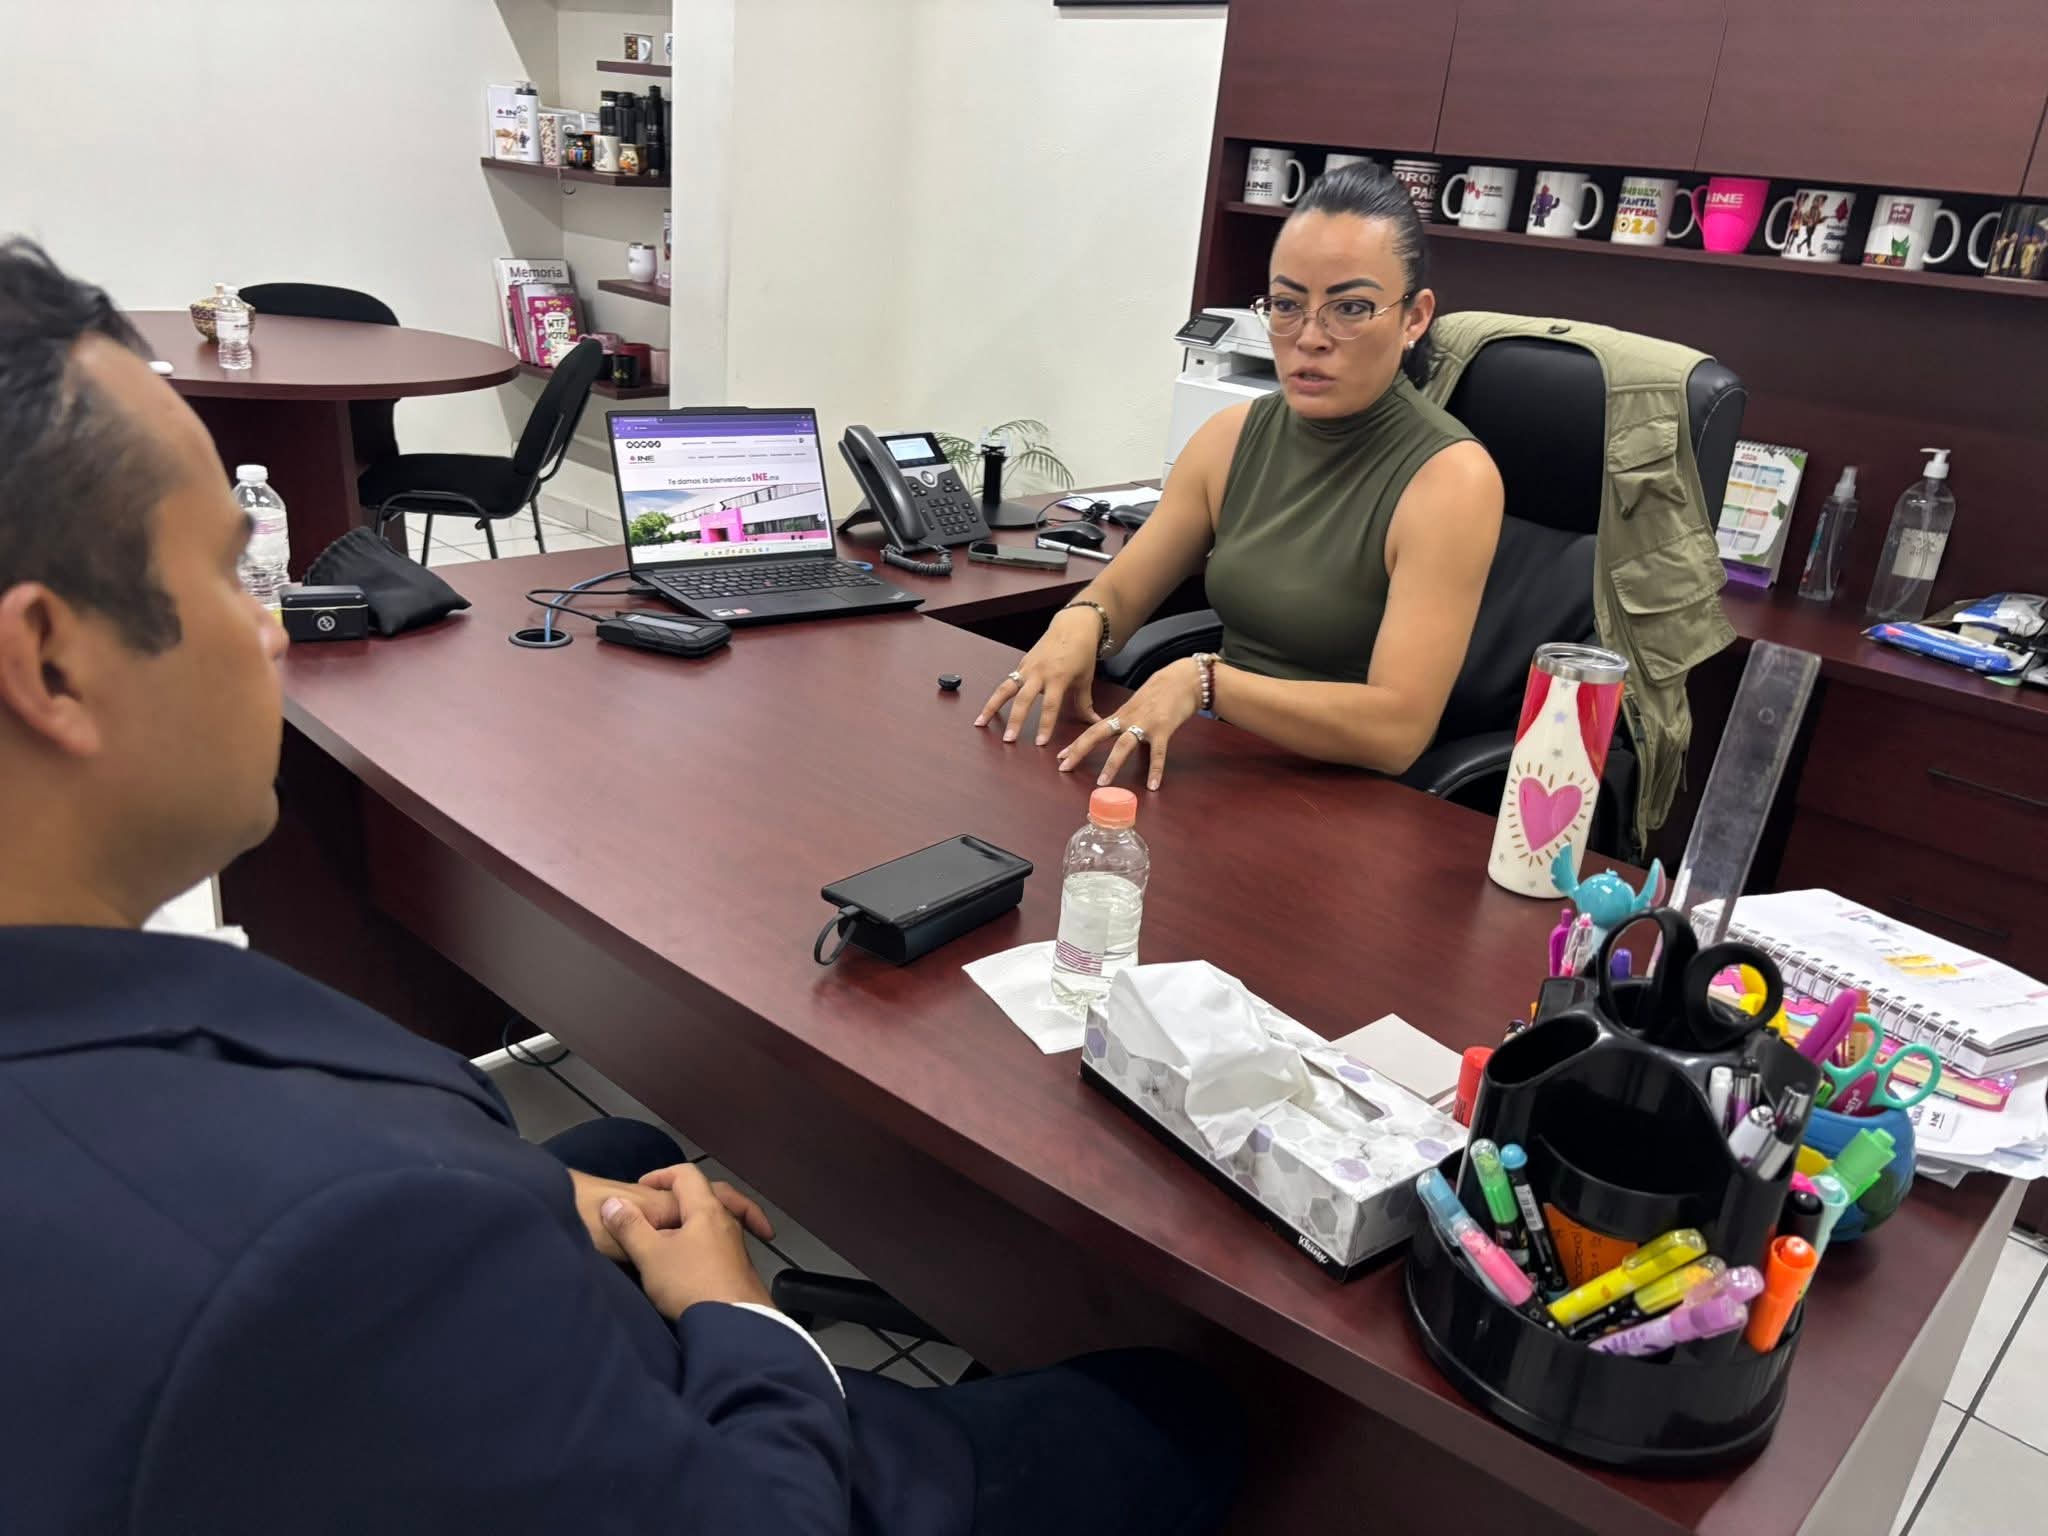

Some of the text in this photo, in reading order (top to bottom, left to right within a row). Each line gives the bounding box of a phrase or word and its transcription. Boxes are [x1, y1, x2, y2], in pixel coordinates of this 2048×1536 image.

[1251, 181, 1272, 190] INE
[1711, 192, 1744, 205] INE
[509, 266, 564, 278] Memoria
